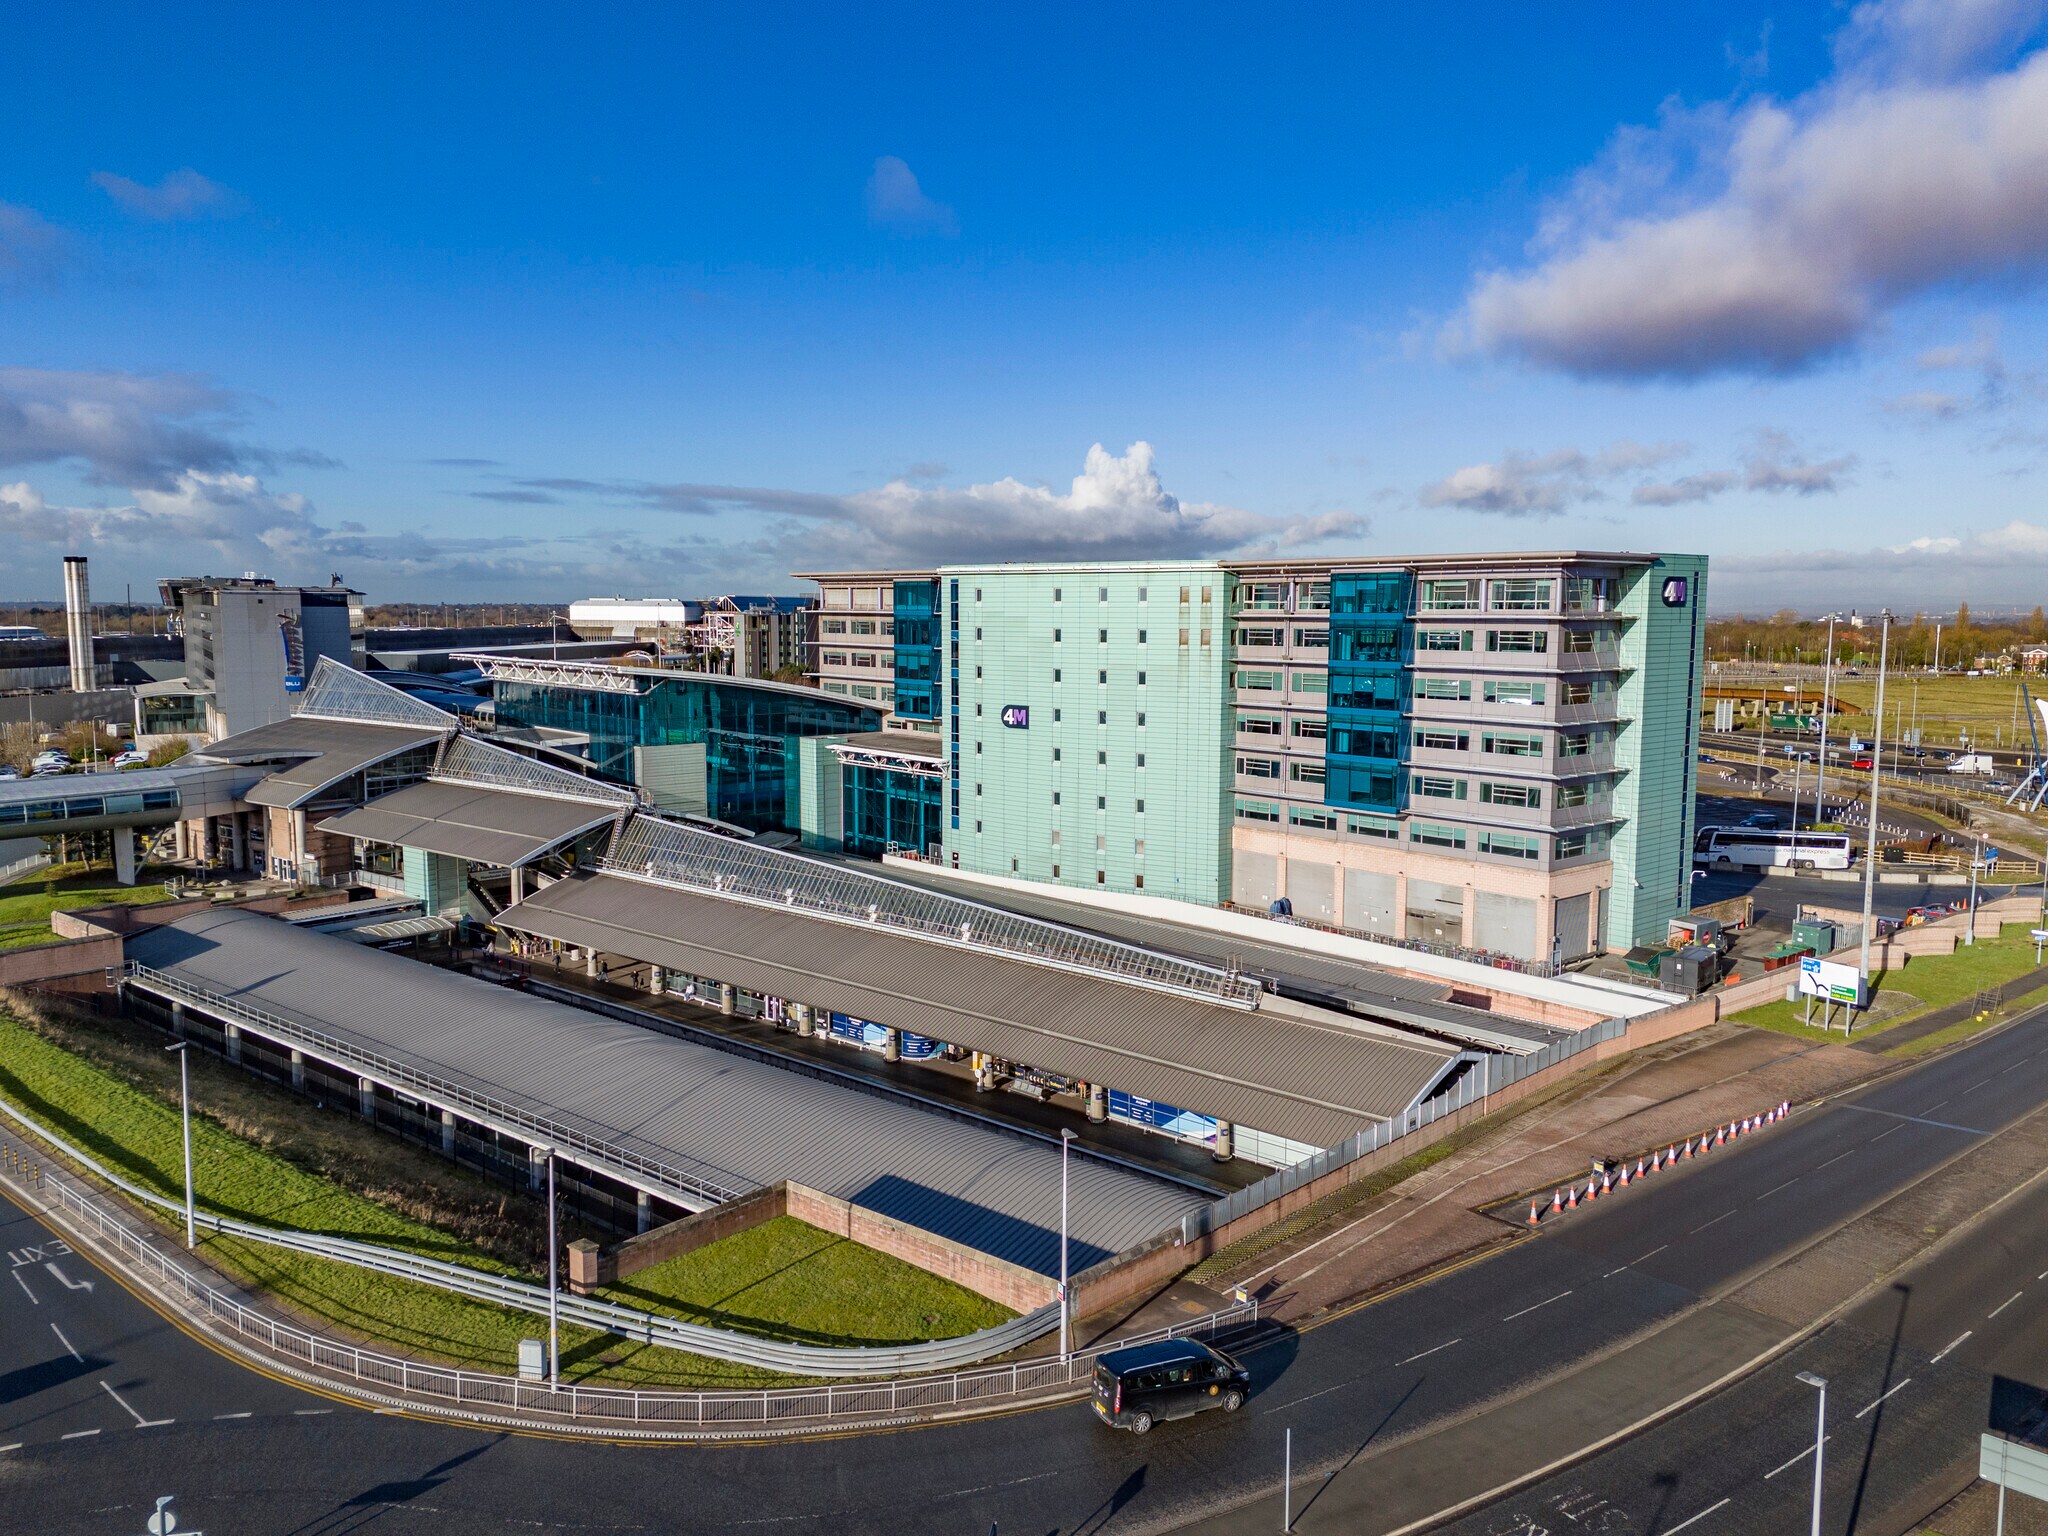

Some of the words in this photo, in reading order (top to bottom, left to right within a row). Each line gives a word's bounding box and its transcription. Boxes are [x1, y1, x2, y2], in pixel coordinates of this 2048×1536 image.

[1664, 580, 1686, 602] 4M
[1003, 708, 1027, 725] 4M
[7, 1239, 73, 1267] EXIT
